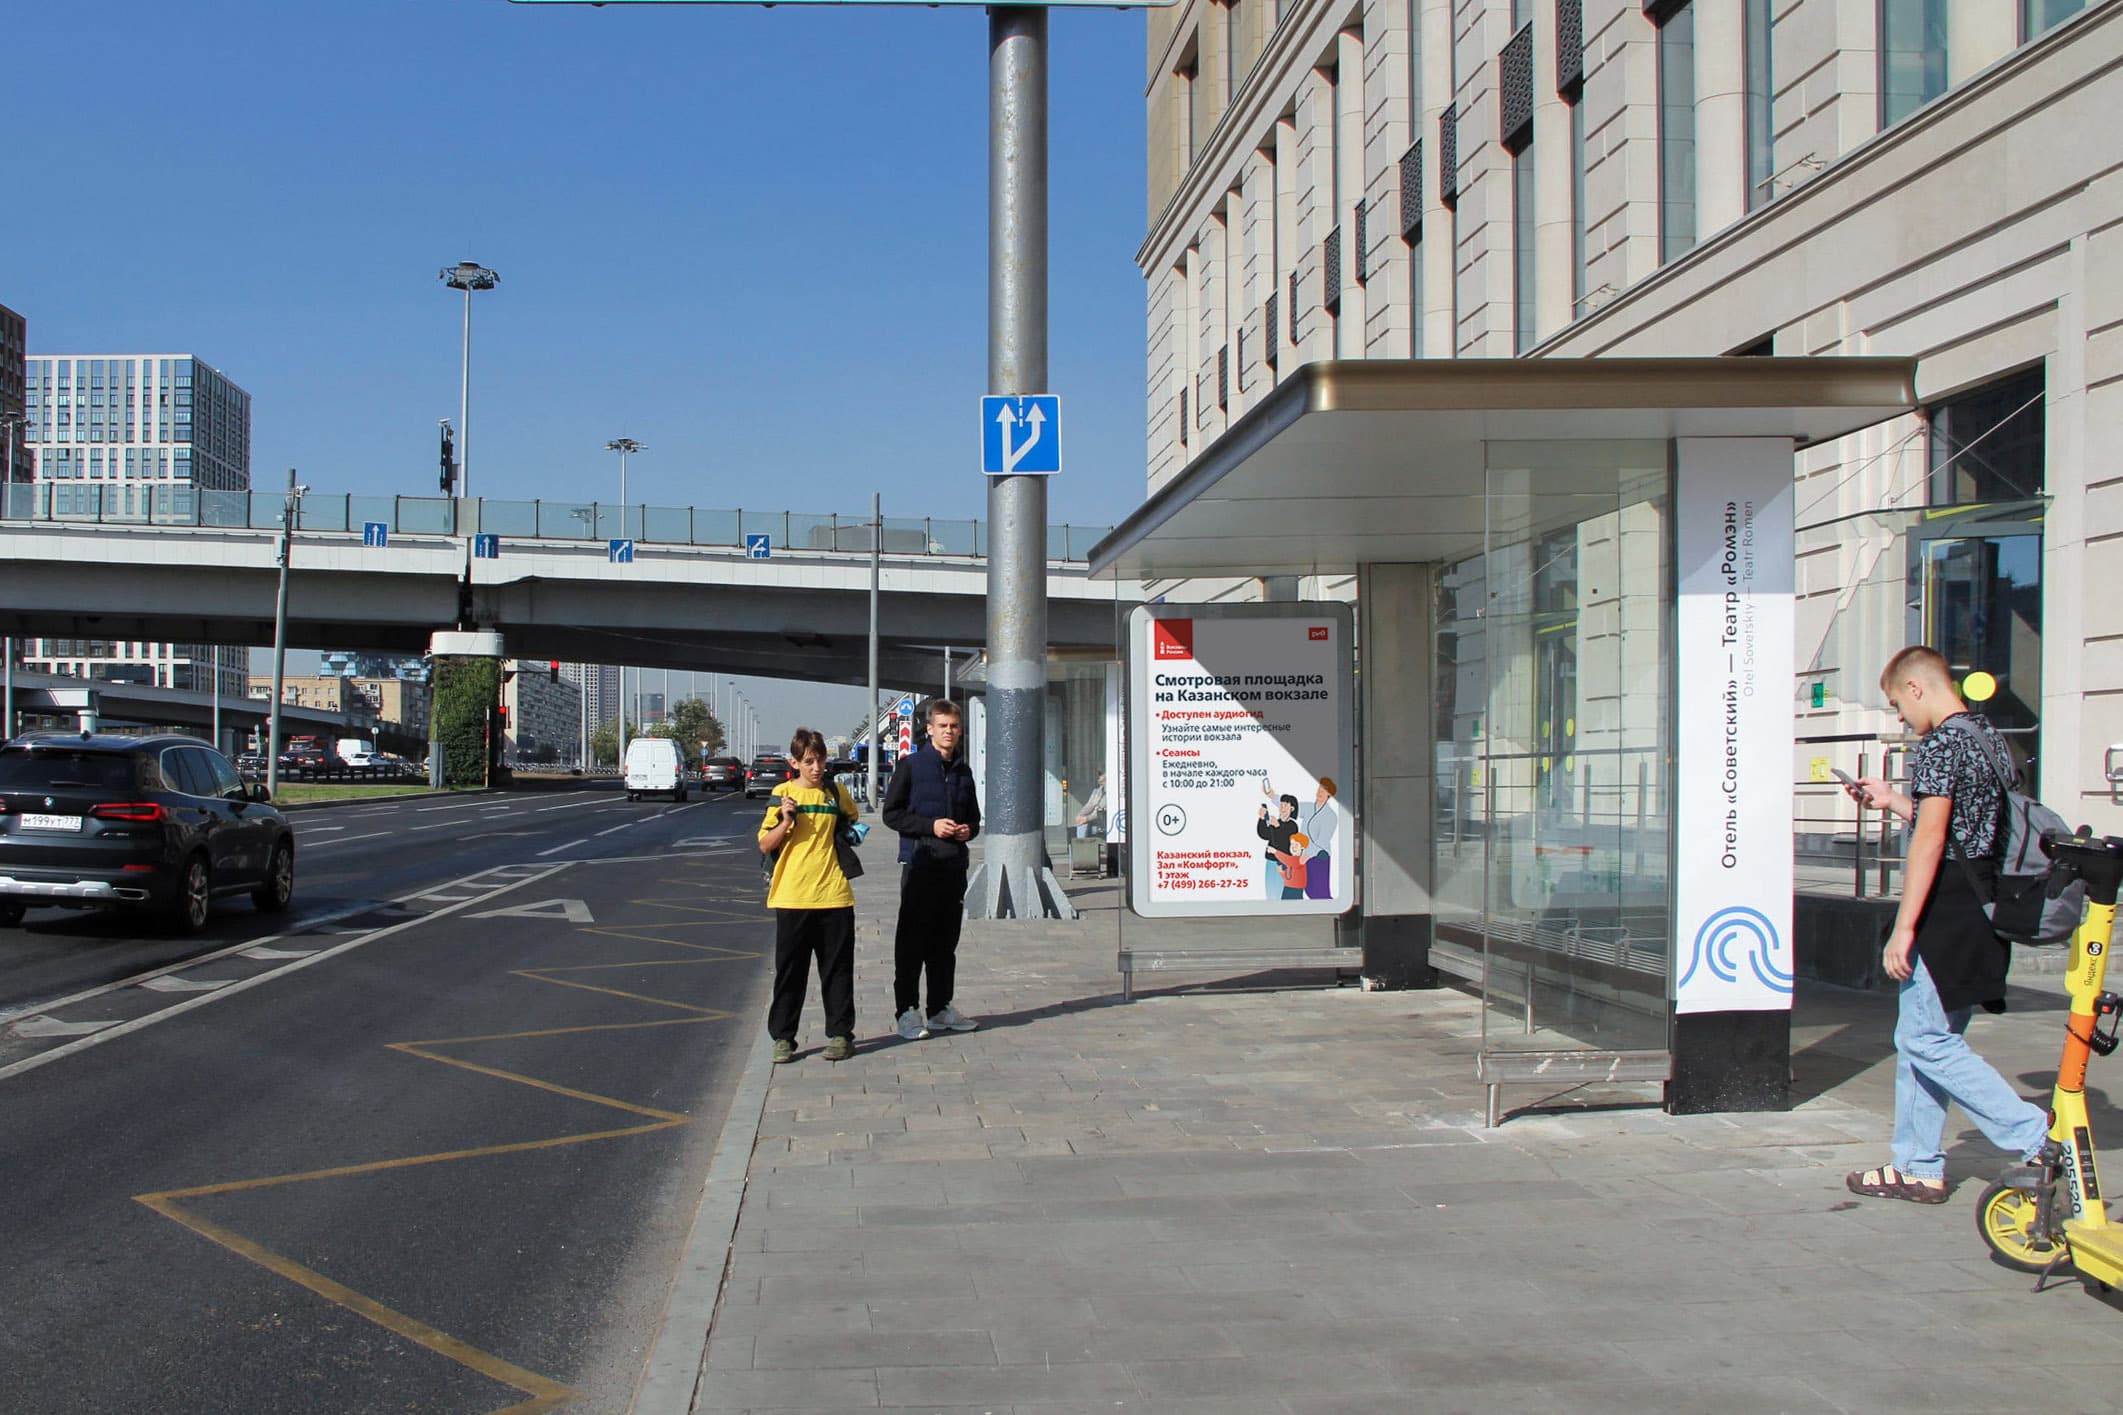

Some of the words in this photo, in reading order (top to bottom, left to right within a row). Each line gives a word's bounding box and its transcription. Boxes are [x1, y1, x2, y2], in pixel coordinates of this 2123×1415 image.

[1743, 501, 1753, 546] Romen
[1721, 501, 1737, 586] «Ромэн»
[1743, 552, 1753, 582] Teatr
[1721, 592, 1740, 647] Театр
[1155, 674, 1240, 689] Смотровая
[1245, 674, 1324, 687] площадка
[1155, 692, 1174, 702] на
[1178, 690, 1262, 702] Казанском
[1265, 690, 1329, 700] вокзале
[1161, 710, 1211, 720] Доступен
[1213, 710, 1264, 720] аудиогид
[1162, 723, 1200, 733] Узнайте
[1234, 723, 1292, 734] интересные
[1162, 734, 1202, 743] истории
[1204, 733, 1242, 741] вокзала
[1721, 680, 1738, 804] «Советский»
[1162, 748, 1200, 757] Сеансы
[1162, 760, 1218, 769] Ежедневно,
[1206, 769, 1245, 778] каждого
[1170, 779, 1194, 788] 10:00
[1196, 780, 1208, 789] до
[1210, 778, 1235, 787] 21:00
[1163, 814, 1180, 826] 0+
[1721, 809, 1737, 869] Отель
[1157, 850, 1211, 859] Казанский
[1213, 851, 1252, 859] вокзал,
[1157, 861, 1175, 869] Зал
[1177, 860, 1239, 871] «Комфорт»,
[1157, 871, 1163, 879] 1
[1157, 880, 1169, 889] +7
[1171, 880, 1196, 890] (499)
[1198, 879, 1249, 888] 266-27-25
[2062, 1145, 2082, 1213] 205520
